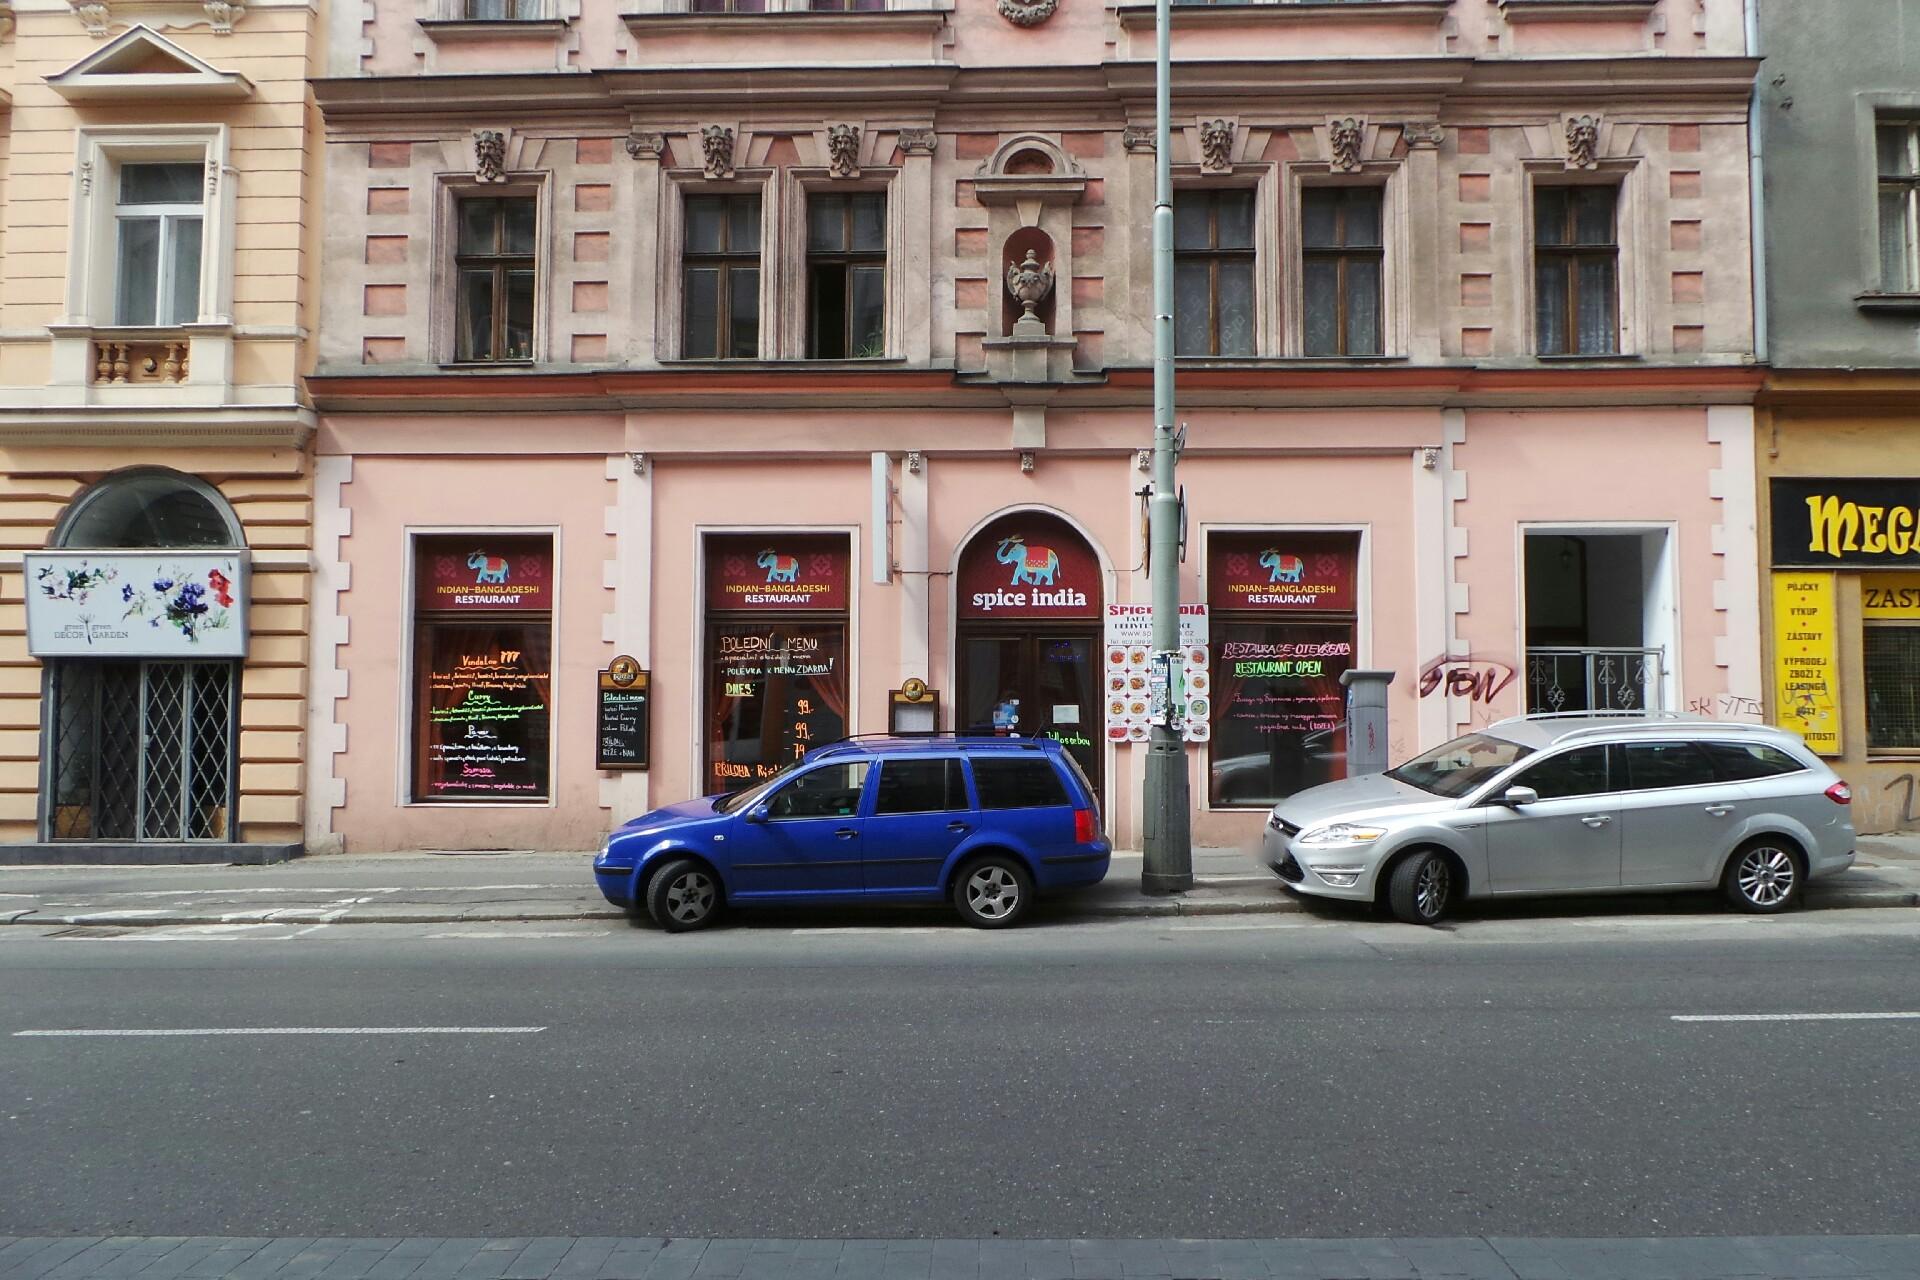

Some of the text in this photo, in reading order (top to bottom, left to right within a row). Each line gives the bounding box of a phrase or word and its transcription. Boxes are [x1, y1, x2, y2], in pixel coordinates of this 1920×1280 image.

[455, 595, 520, 604] RESTAURANT
[745, 595, 811, 603] RESTAURANT
[973, 588, 1087, 610] spice india
[1248, 595, 1317, 603] RESTAURANT
[721, 632, 817, 652] POLEDNÍ MENU
[1235, 661, 1322, 674] RESTAURANT OPEN
[1816, 670, 1822, 678] Z
[725, 683, 756, 694] DNES:
[468, 690, 491, 703] Curry
